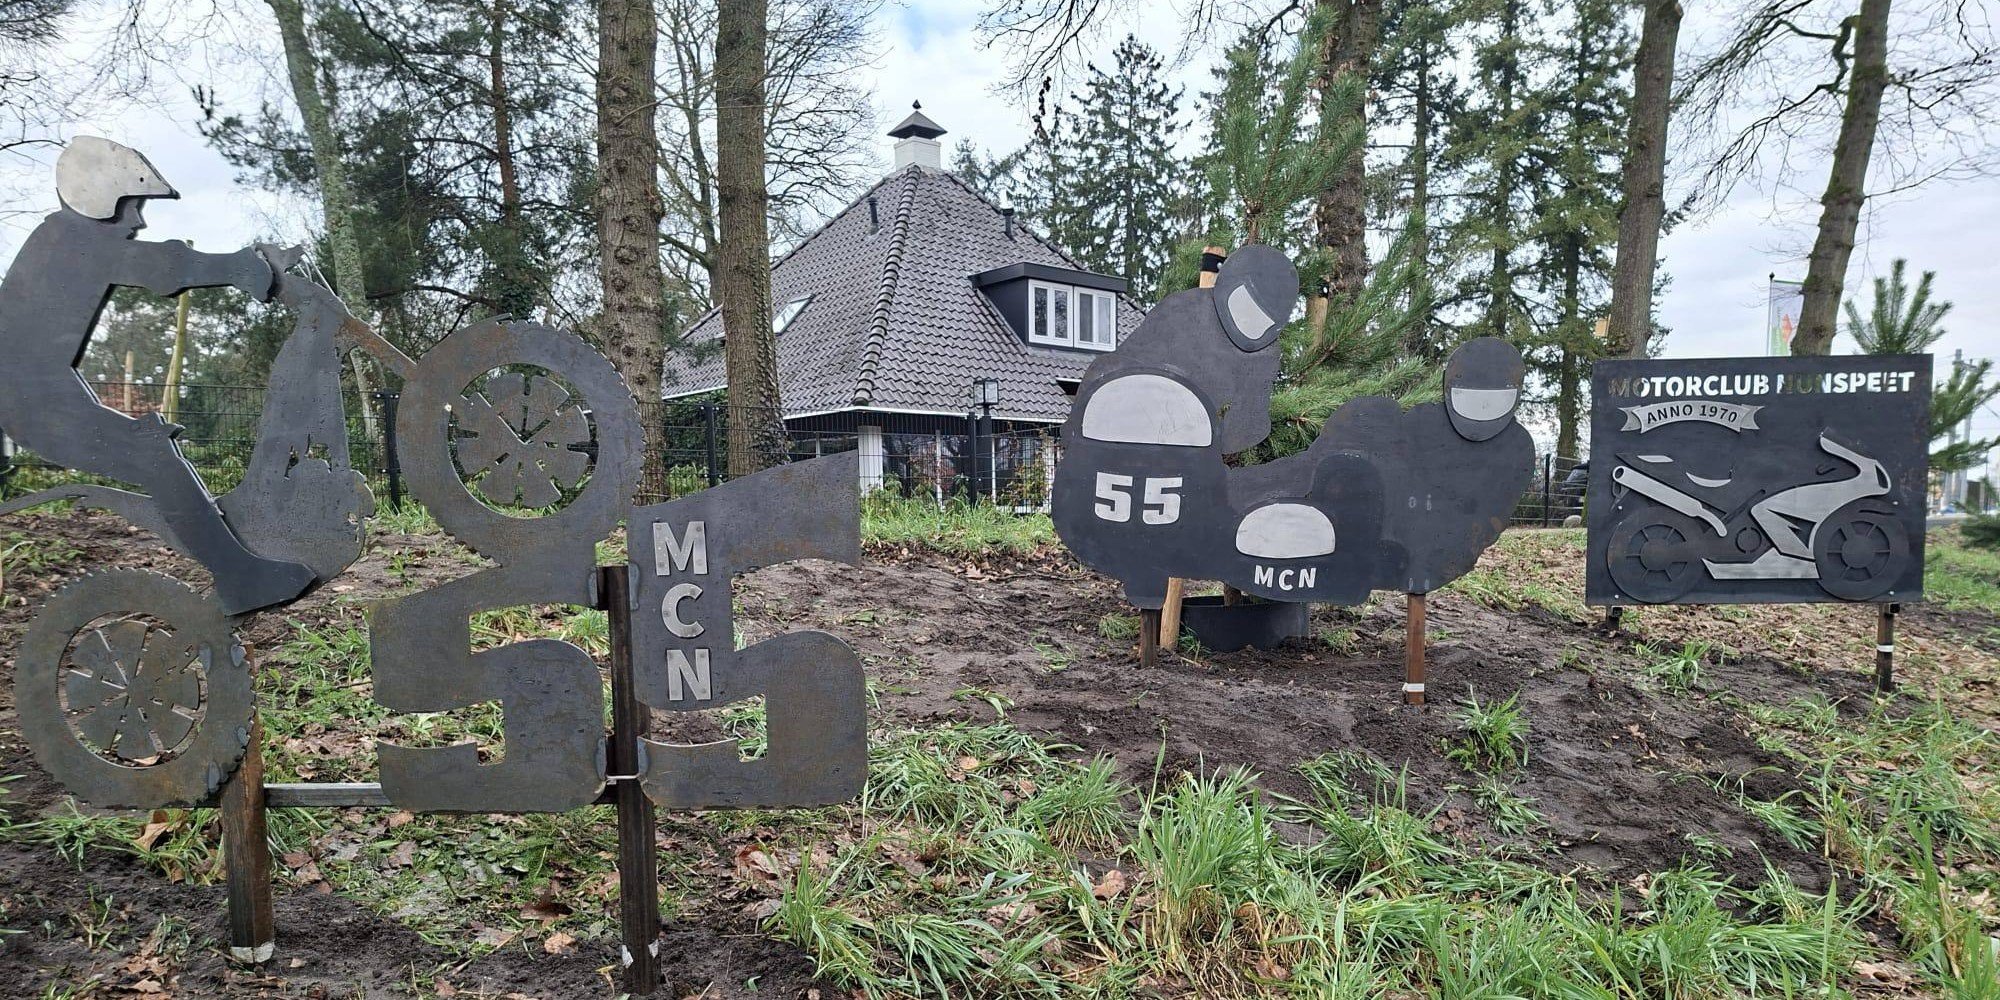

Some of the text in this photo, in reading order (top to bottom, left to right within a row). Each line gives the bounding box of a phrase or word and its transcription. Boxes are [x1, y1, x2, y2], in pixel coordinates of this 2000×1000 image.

[1608, 371, 1915, 398] MOTORCLUB NUNSPEET
[1647, 404, 1738, 424] ANNO 1970
[1094, 471, 1183, 525] 55
[1254, 564, 1317, 591] MCN
[652, 520, 713, 701] MCN
